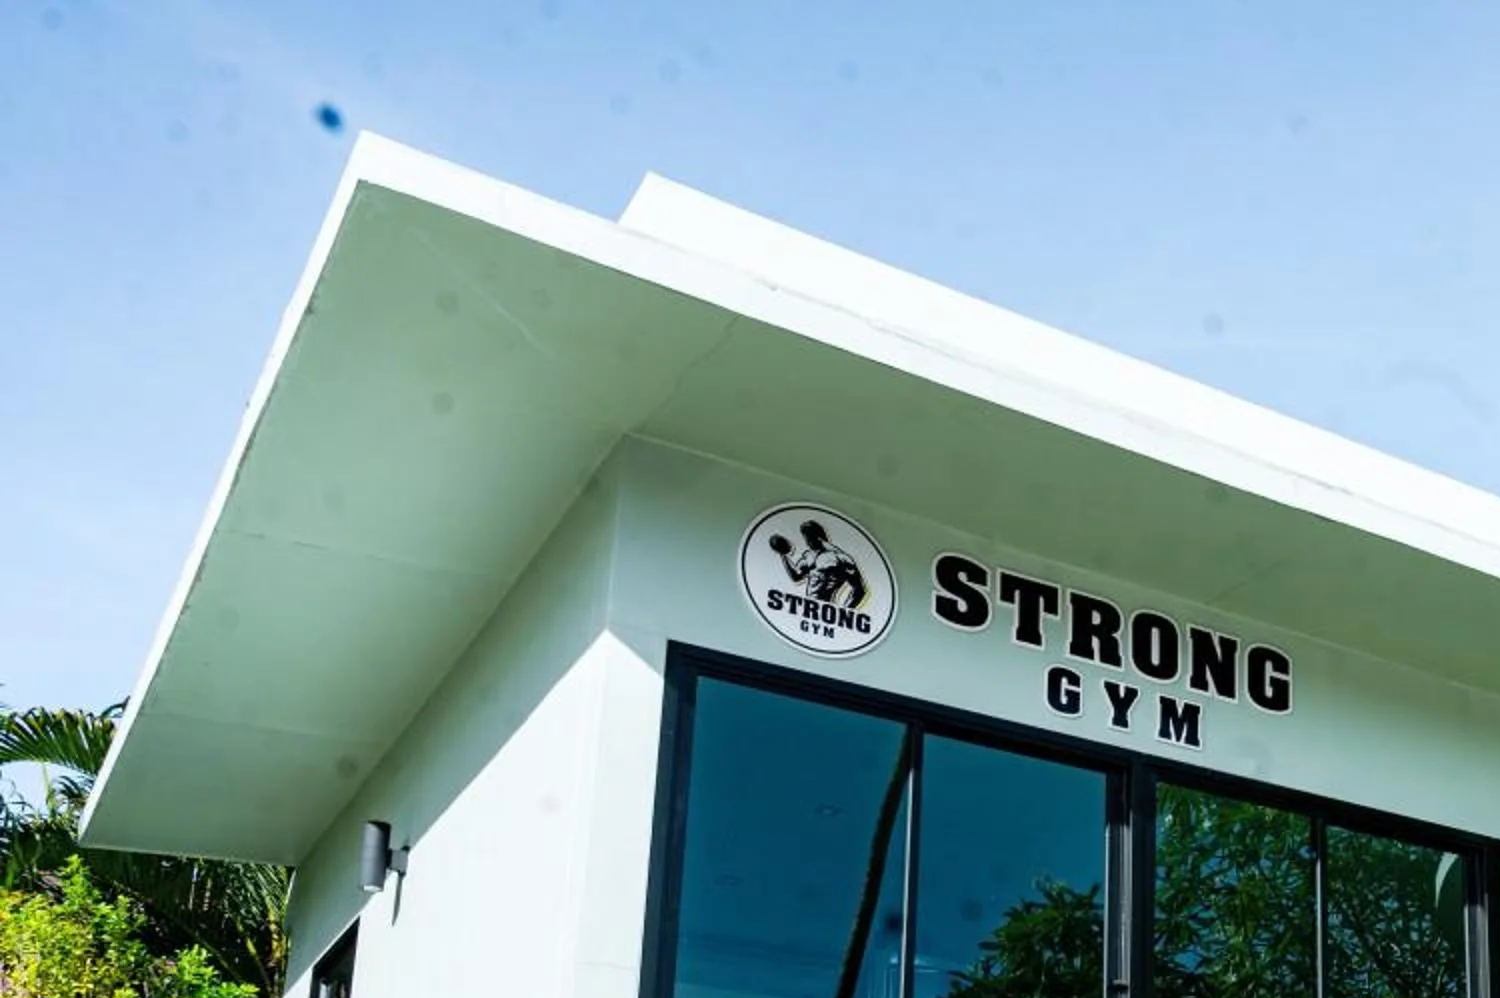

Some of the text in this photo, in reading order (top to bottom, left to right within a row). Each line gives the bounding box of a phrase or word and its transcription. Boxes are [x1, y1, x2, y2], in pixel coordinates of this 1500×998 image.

[767, 589, 871, 635] STRONG
[800, 620, 835, 639] GYM
[934, 554, 1291, 713] STRONG
[1047, 666, 1201, 747] GYM
